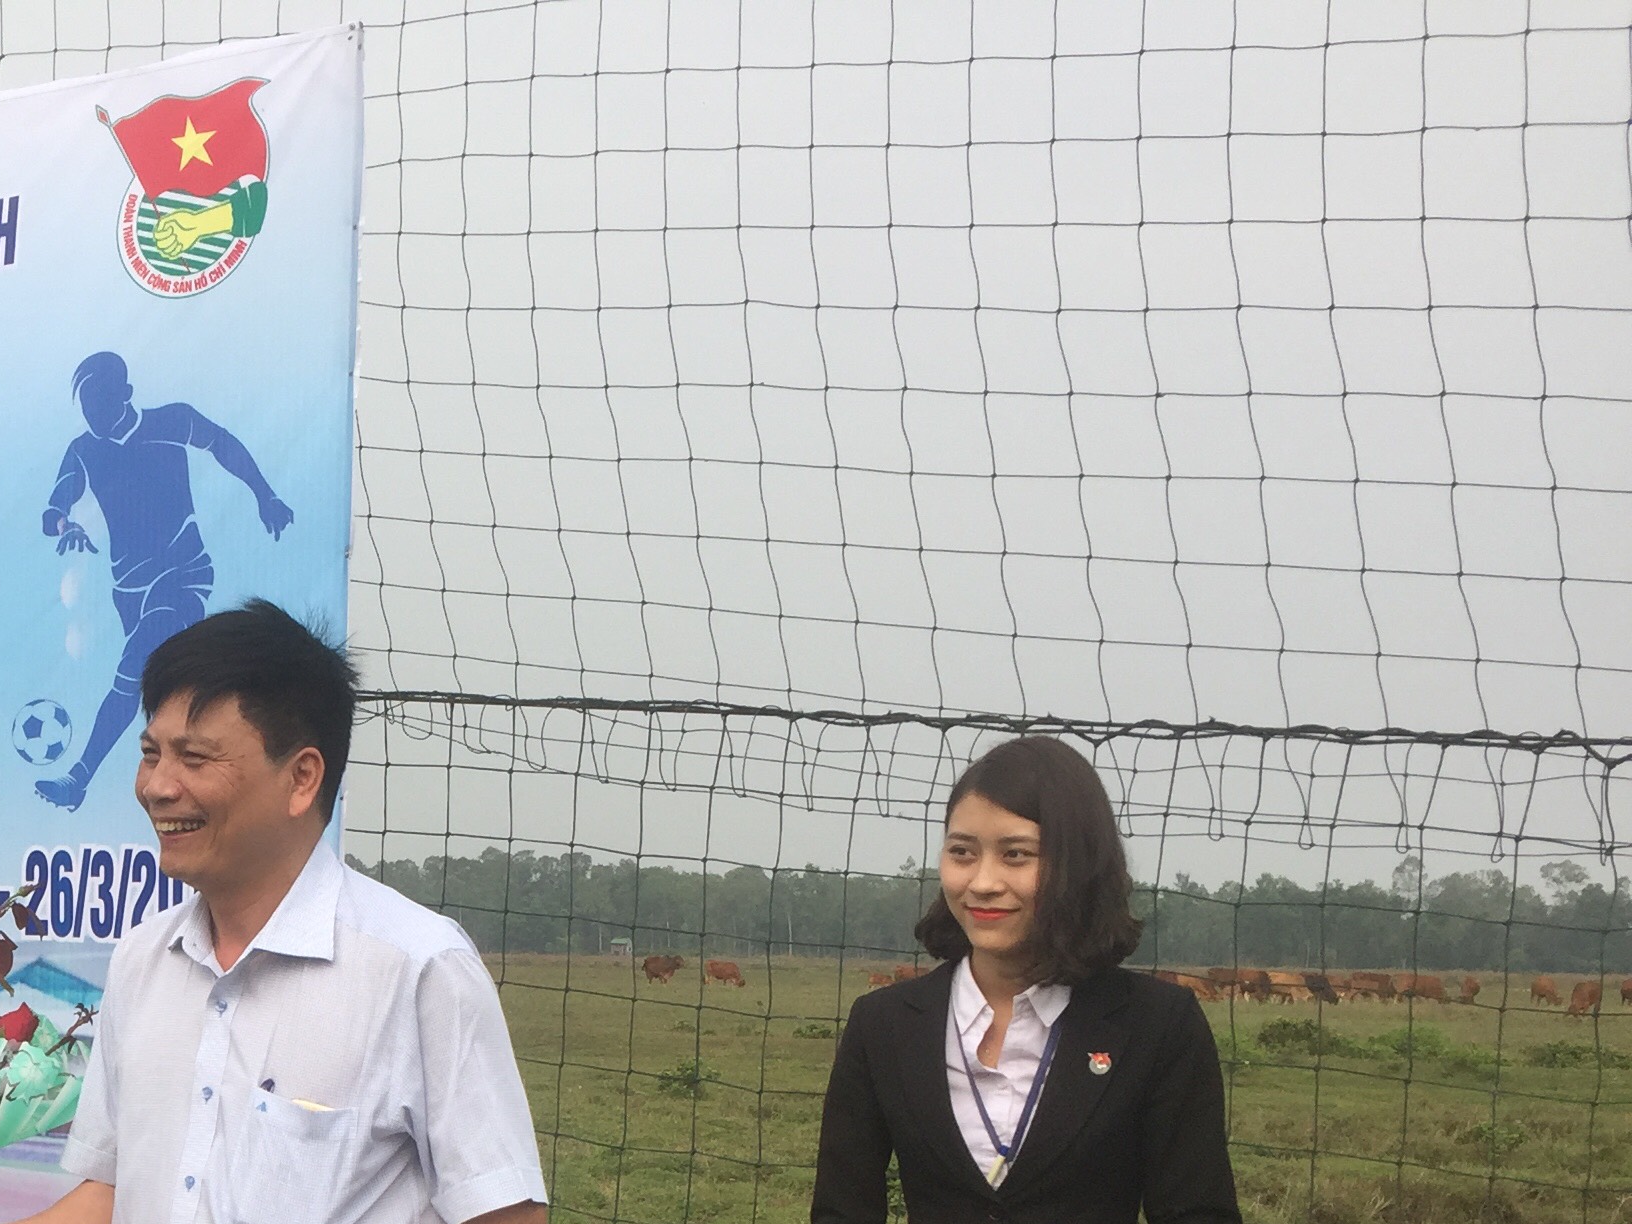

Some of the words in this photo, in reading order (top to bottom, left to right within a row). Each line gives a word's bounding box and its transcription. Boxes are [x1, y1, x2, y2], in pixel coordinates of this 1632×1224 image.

[122, 225, 137, 259] THANH
[209, 262, 226, 283] CHÍ
[224, 239, 248, 269] MINH
